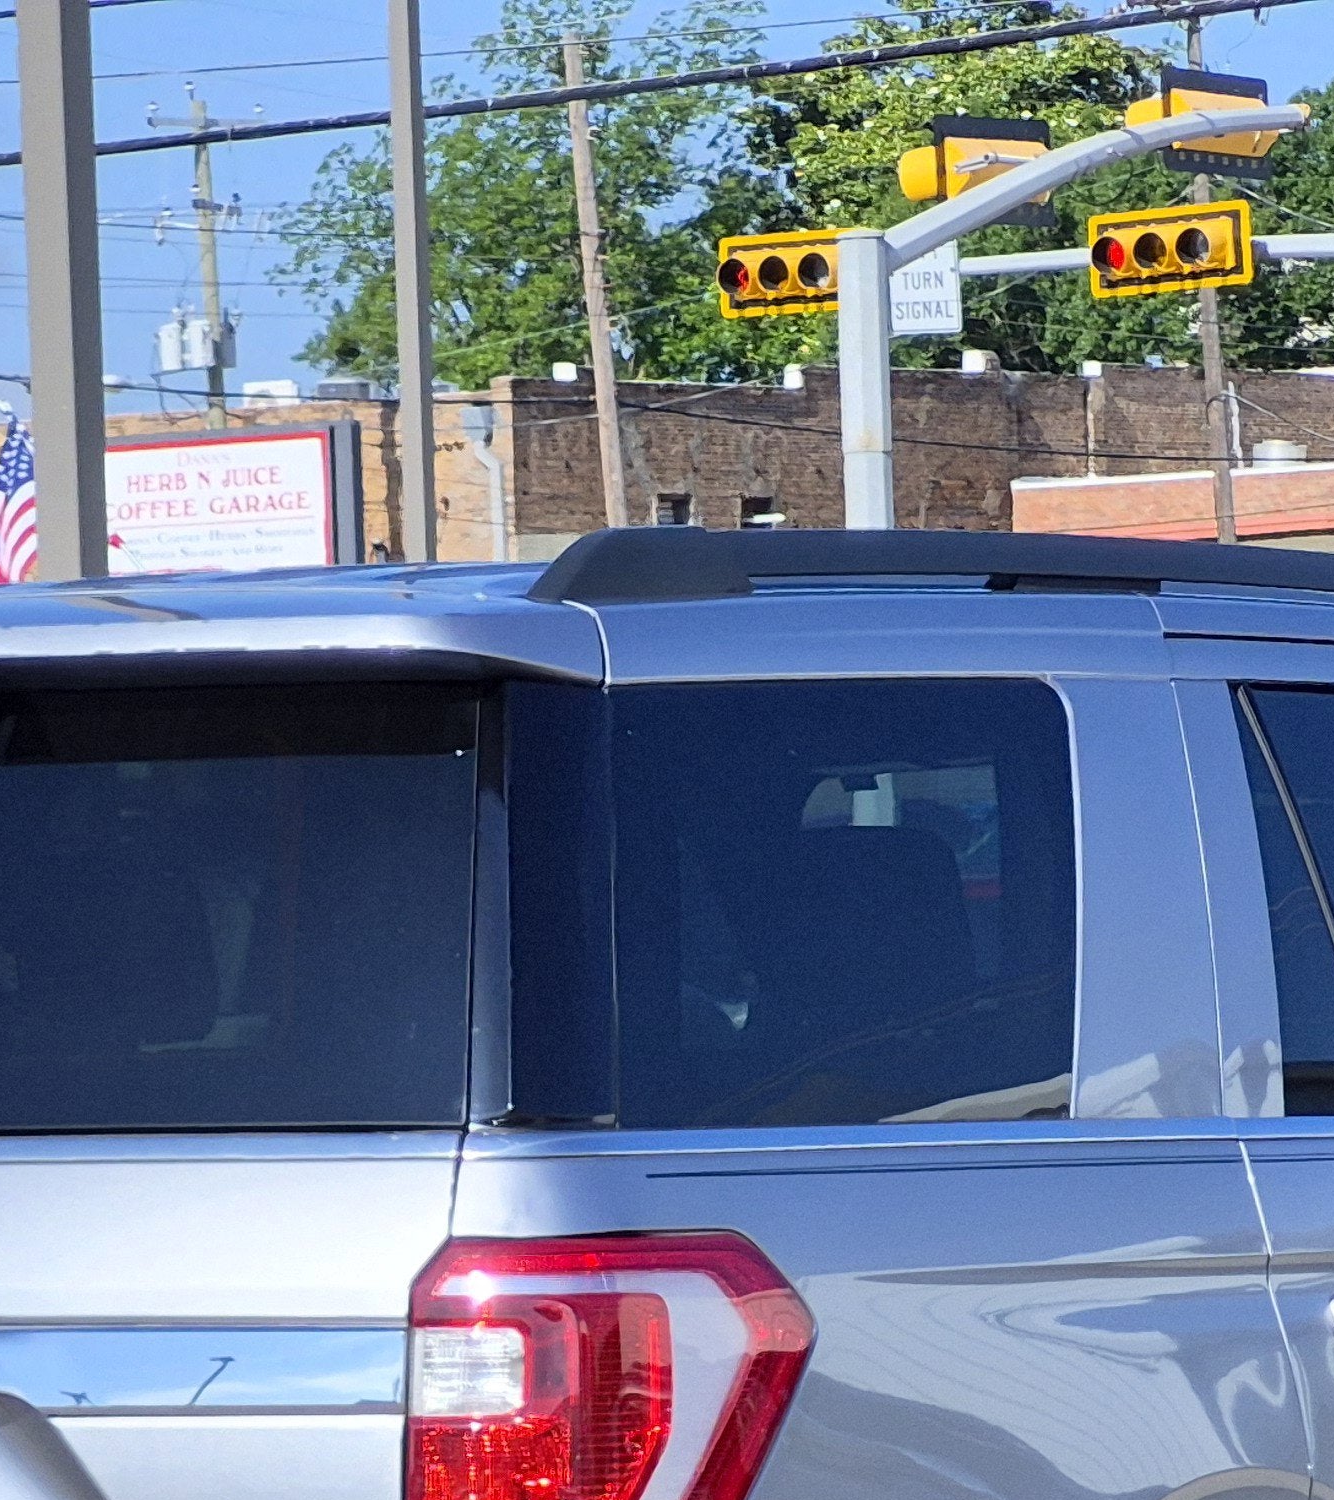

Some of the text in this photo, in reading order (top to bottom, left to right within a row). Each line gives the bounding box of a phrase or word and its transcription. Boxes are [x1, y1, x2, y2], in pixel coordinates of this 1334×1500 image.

[902, 270, 944, 291] TURN
[895, 300, 954, 320] SIGNAL
[126, 465, 283, 494] HERB N JUICE
[209, 491, 311, 515] GARAGE
